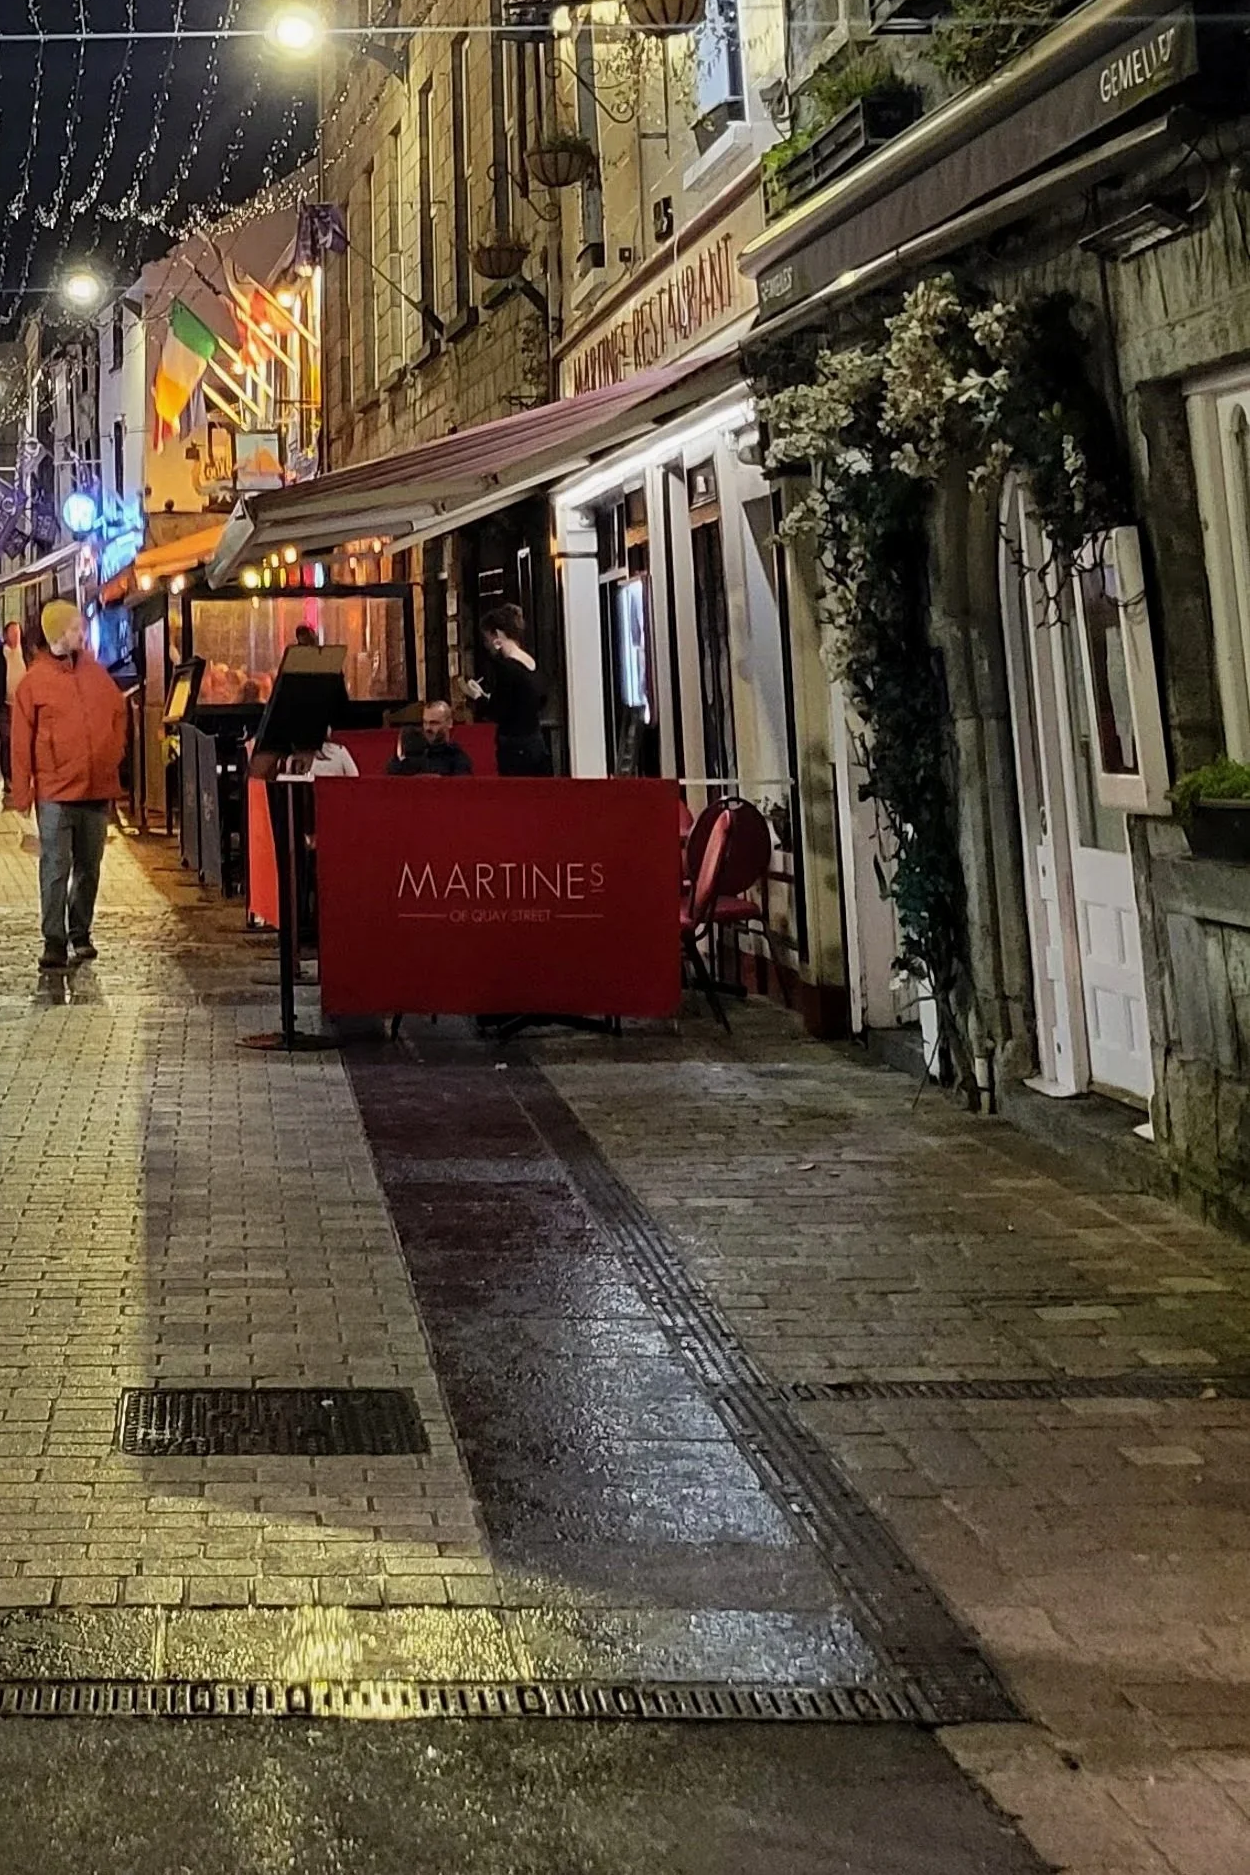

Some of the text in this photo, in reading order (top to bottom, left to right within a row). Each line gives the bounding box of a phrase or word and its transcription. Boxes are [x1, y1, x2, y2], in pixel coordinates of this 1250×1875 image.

[631, 232, 733, 373] RESTAURANT
[449, 908, 551, 923] OF QUAY STREET
